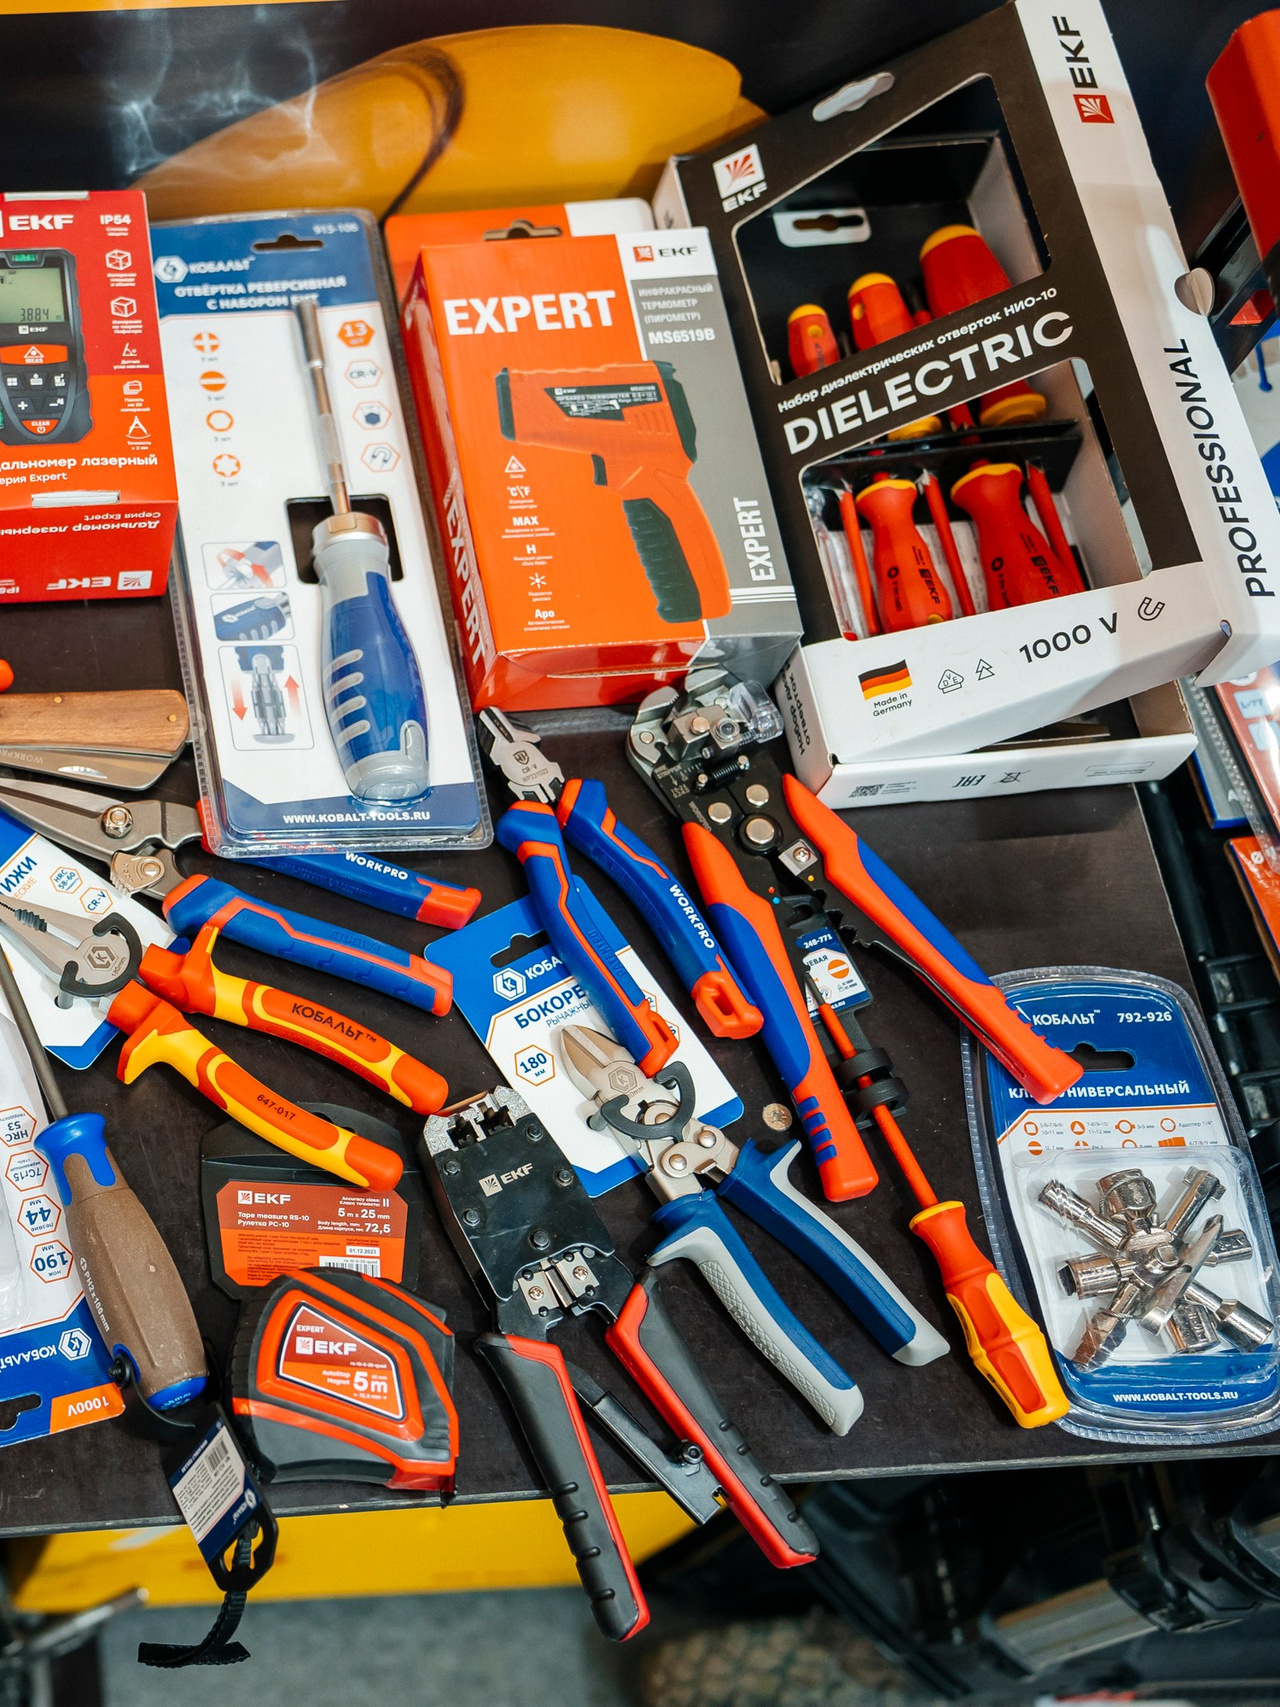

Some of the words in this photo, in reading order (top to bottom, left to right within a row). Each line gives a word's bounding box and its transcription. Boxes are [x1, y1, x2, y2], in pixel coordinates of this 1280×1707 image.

[1052, 16, 1098, 89] EKF
[722, 182, 768, 213] EKF
[8, 214, 74, 230] EKF
[658, 245, 698, 257] EKF
[189, 260, 251, 274] КОБАЛЬТ
[247, 276, 346, 293] РЕВЕРСИВНАЯ
[638, 282, 714, 297] ИНФРАКРАСНЫЙ
[207, 299, 218, 310] С
[221, 295, 288, 309] НАБОРОМ
[640, 298, 698, 311] ТЕРМОМЕТР
[443, 290, 616, 336] EXPERT
[644, 311, 701, 326] (ПИРОМЕТР)
[342, 324, 368, 337] 13
[648, 328, 717, 345] MS6519B
[777, 388, 819, 413] Набор
[820, 340, 935, 398] диэлектрических
[936, 311, 1002, 345] отверток
[1004, 287, 1058, 318] НИО-10
[349, 369, 378, 380] CR-V
[783, 311, 1074, 455] DIELECTRIC
[81, 454, 158, 467] лазерный
[1163, 339, 1275, 597] PROFESSIONAL
[29, 472, 67, 484] Expert
[124, 512, 161, 520] Серия
[512, 516, 539, 526] MAX
[72, 520, 160, 533] Дальномер
[733, 497, 776, 581] EXPERT
[526, 544, 537, 554] H
[46, 577, 111, 590] EKF
[444, 496, 486, 666] EXPERT
[1038, 567, 1059, 595] EKF
[924, 579, 941, 605] EKF
[535, 609, 555, 620] Apo
[1019, 624, 1092, 664] 1000
[1099, 612, 1118, 634] V
[873, 700, 912, 717] Germany
[874, 696, 898, 708] Made
[283, 811, 431, 824] WWW.KOBALT-TOOLS.RU
[344, 850, 409, 881] WORKPRO
[54, 869, 68, 883] HRC
[58, 872, 76, 890] 58-60
[87, 891, 107, 911] CR-V
[668, 884, 715, 950] WORKPRO
[803, 934, 833, 949] 248-771
[111, 956, 127, 978] 180mm
[525, 956, 563, 980] КОБА
[514, 984, 587, 1029] БОКОРЕ
[1033, 1013, 1095, 1025] КОБАЛЬТ
[1117, 1012, 1172, 1023] 792-926
[520, 1052, 547, 1074] 180
[534, 1069, 546, 1078] мм
[256, 1093, 296, 1121] 647-017
[8, 1121, 21, 1131] 53
[5, 1129, 28, 1143] HRC
[13, 1166, 42, 1182] 7Cr15
[499, 1162, 533, 1185] EKF
[254, 1194, 291, 1205] EKF
[26, 1206, 51, 1226] 44
[238, 1212, 255, 1220] Tape
[338, 1208, 345, 1217] 5
[360, 1209, 376, 1218] 25
[237, 1220, 267, 1228] Рулетка
[364, 1223, 391, 1234] 72,5
[34, 1251, 69, 1272] 190
[297, 1325, 324, 1333] EXPERT
[315, 1340, 357, 1355] EKF
[353, 1371, 368, 1391] 5
[371, 1381, 387, 1393] m
[1113, 1391, 1239, 1402] WWW.KOBALT-TOOLS.RU
[67, 1395, 109, 1417] 1000V
